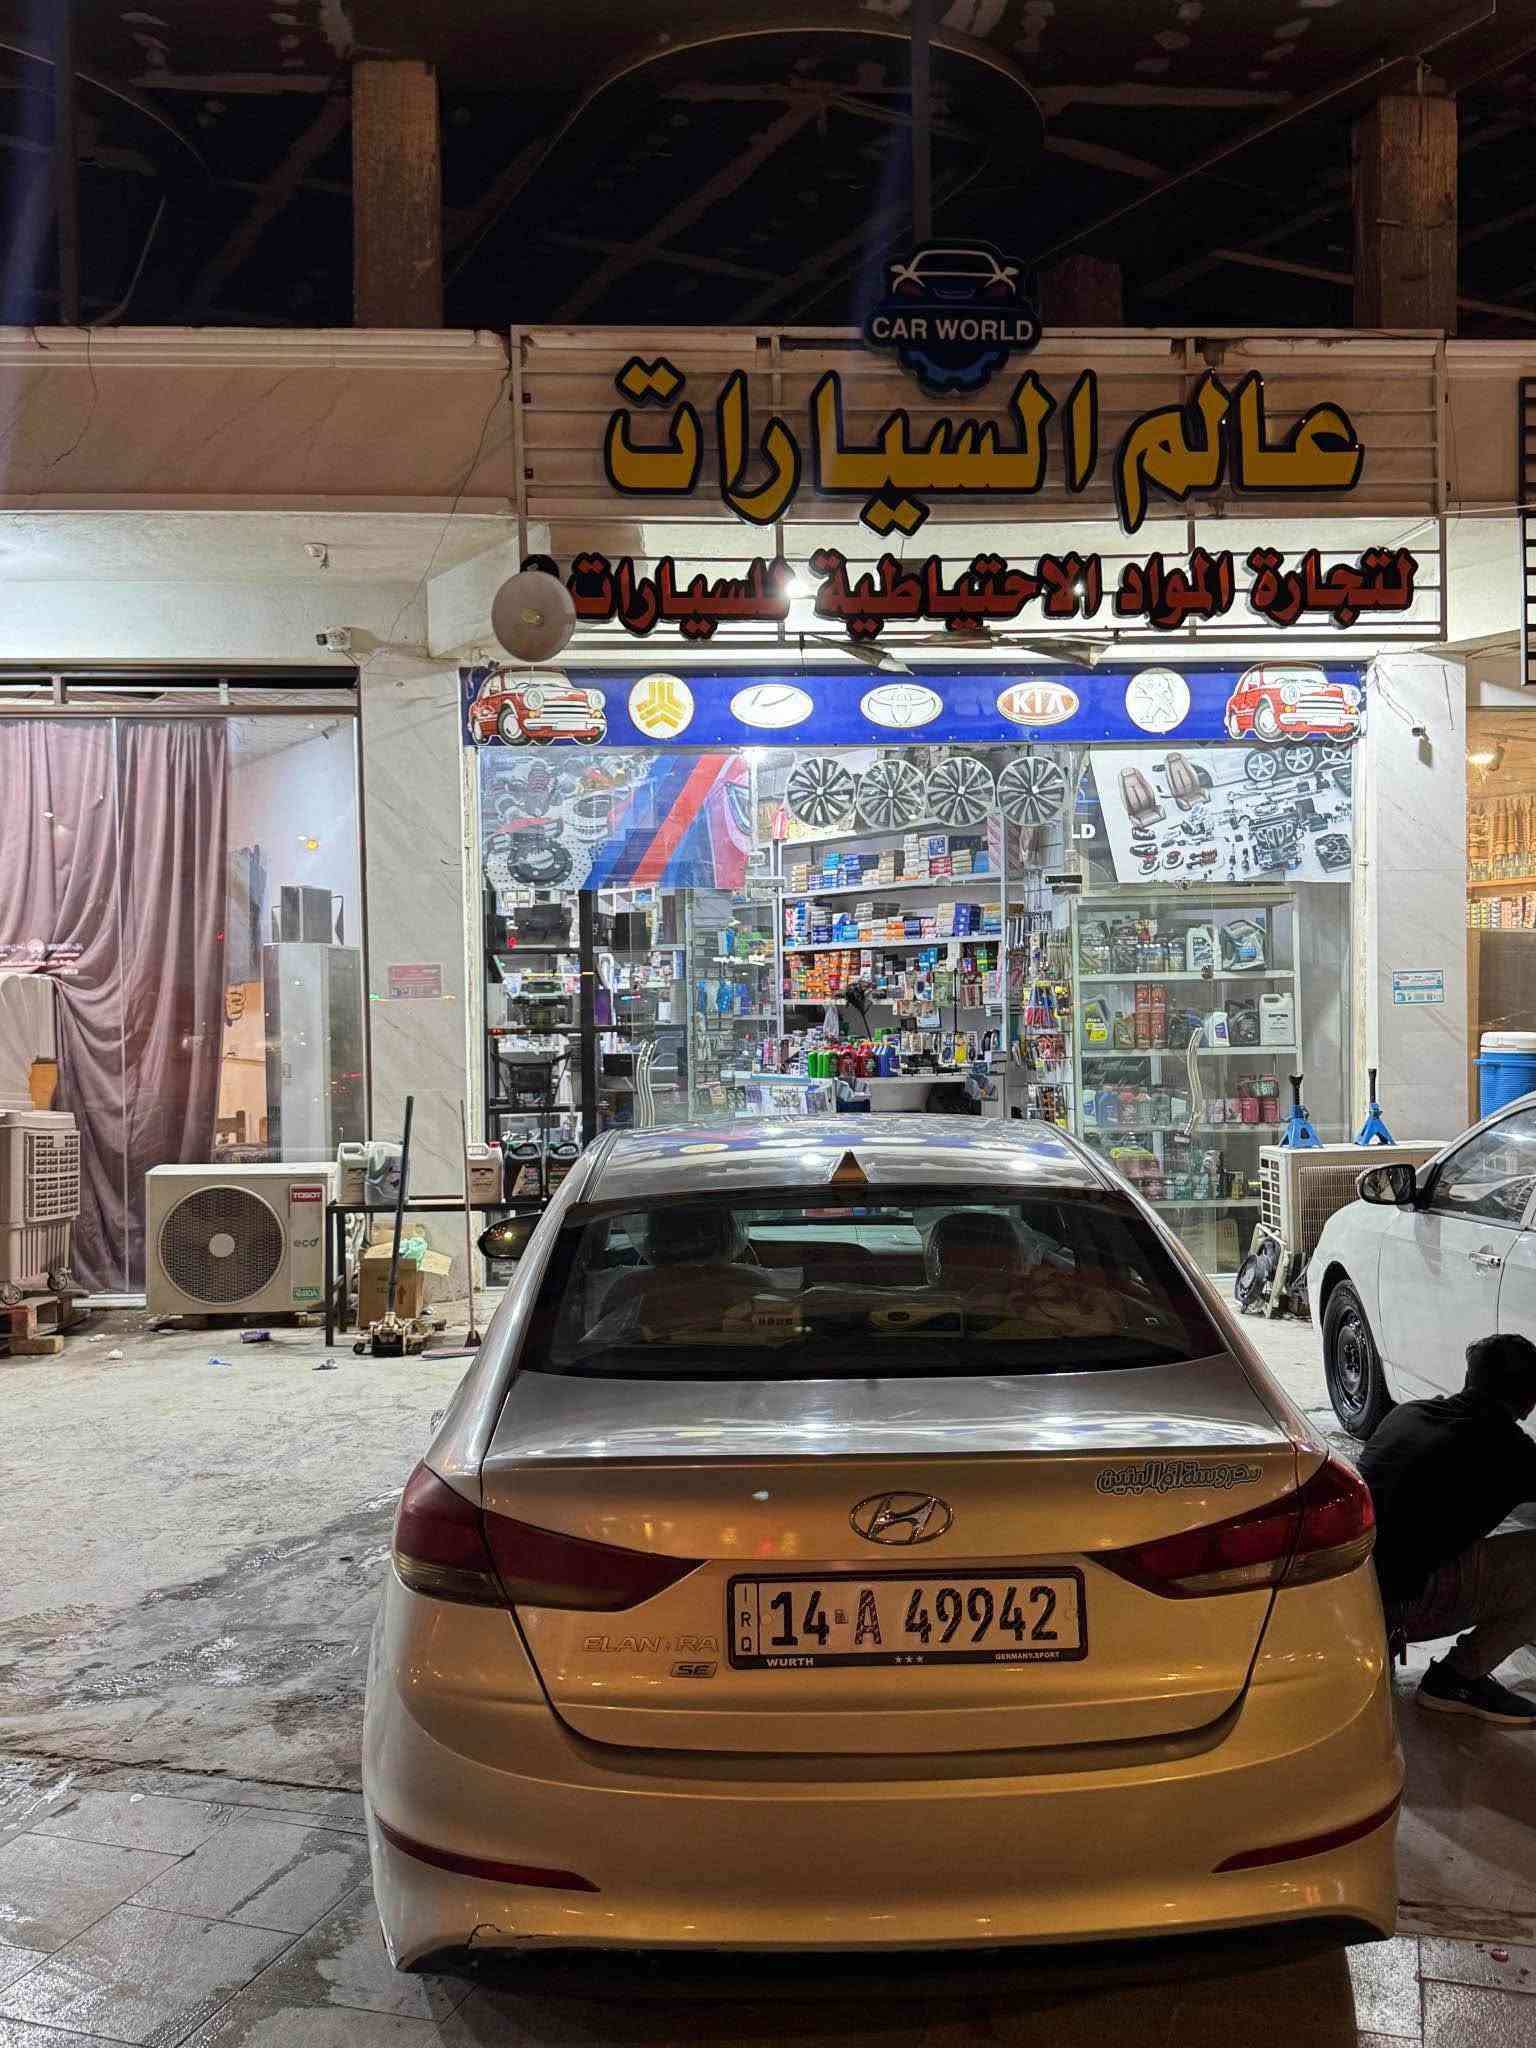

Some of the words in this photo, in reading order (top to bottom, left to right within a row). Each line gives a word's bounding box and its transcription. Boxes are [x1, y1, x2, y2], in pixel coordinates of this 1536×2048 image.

[872, 317, 928, 340] CAR
[935, 319, 1034, 341] WORLD
[604, 357, 1098, 537] السيارات
[1115, 368, 1366, 534] عالم
[566, 551, 791, 639] للسيارات
[810, 548, 1103, 640] الاحتياطية
[1115, 547, 1236, 630] المواد
[1247, 547, 1419, 628] لتجارة
[1012, 688, 1068, 714] KIA
[584, 1636, 719, 1653] ELANRA
[770, 1590, 830, 1646] 14
[854, 1589, 882, 1645] A
[905, 1586, 1058, 1644] 49942
[676, 1664, 711, 1676] SE
[766, 1656, 815, 1668] WURTH
